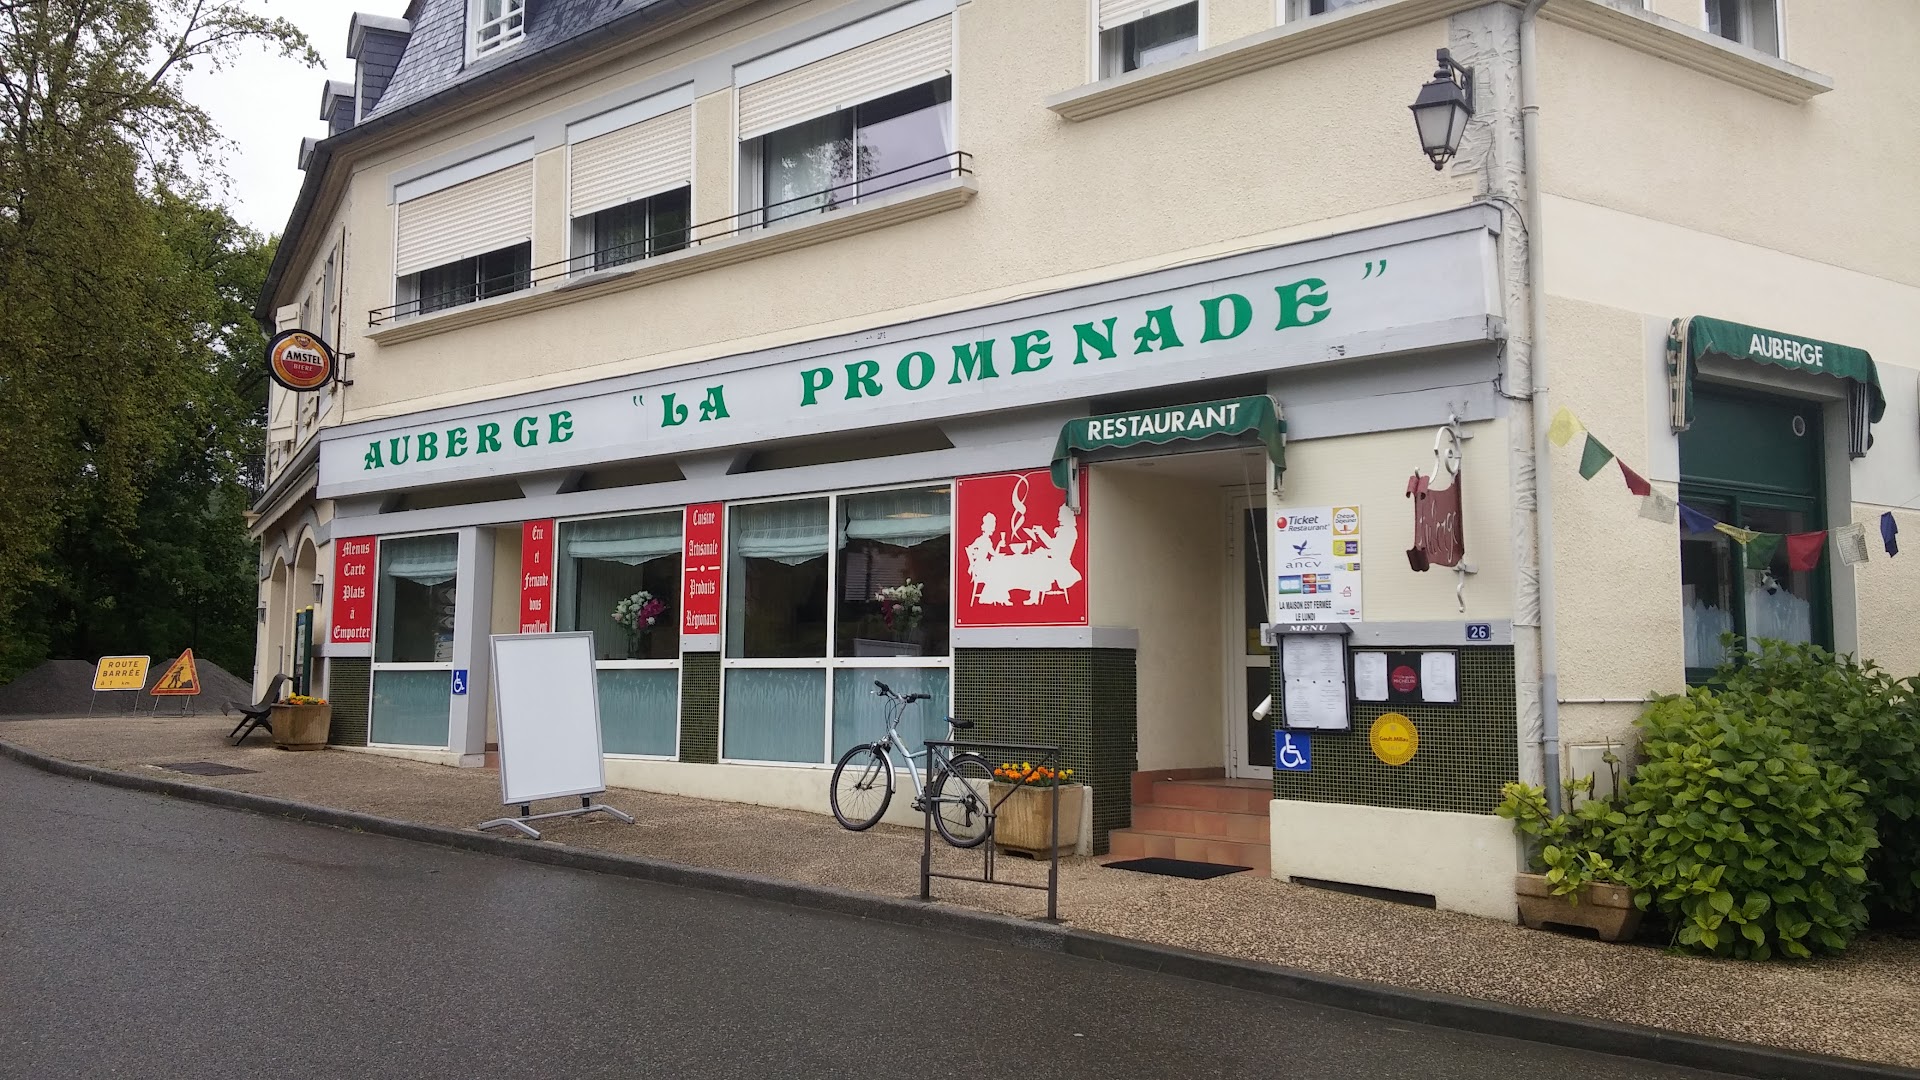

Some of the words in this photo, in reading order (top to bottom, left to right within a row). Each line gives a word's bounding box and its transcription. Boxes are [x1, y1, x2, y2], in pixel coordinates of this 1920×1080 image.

[286, 350, 322, 364] AMSTEL
[1748, 333, 1823, 367] AUBERGE
[1087, 402, 1240, 441] RESTAURANT
[364, 410, 574, 471] AUBERGE
[692, 509, 715, 526] Cuisine
[1289, 515, 1319, 525] Ticket
[342, 541, 371, 557] Menus
[688, 539, 718, 557] Artisanale
[534, 550, 540, 563] et
[343, 562, 366, 577] Carte
[1285, 561, 1322, 569] ancv
[342, 584, 365, 601] Plats
[689, 578, 716, 598] Produits
[1279, 601, 1285, 610] LA
[1286, 601, 1303, 610] MAISON
[1304, 601, 1313, 609] EST
[1295, 613, 1301, 621] LE
[333, 625, 371, 641] Emporter
[1289, 624, 1328, 632] MENU
[1471, 626, 1486, 638] 26
[102, 669, 141, 677] BARRÉE
